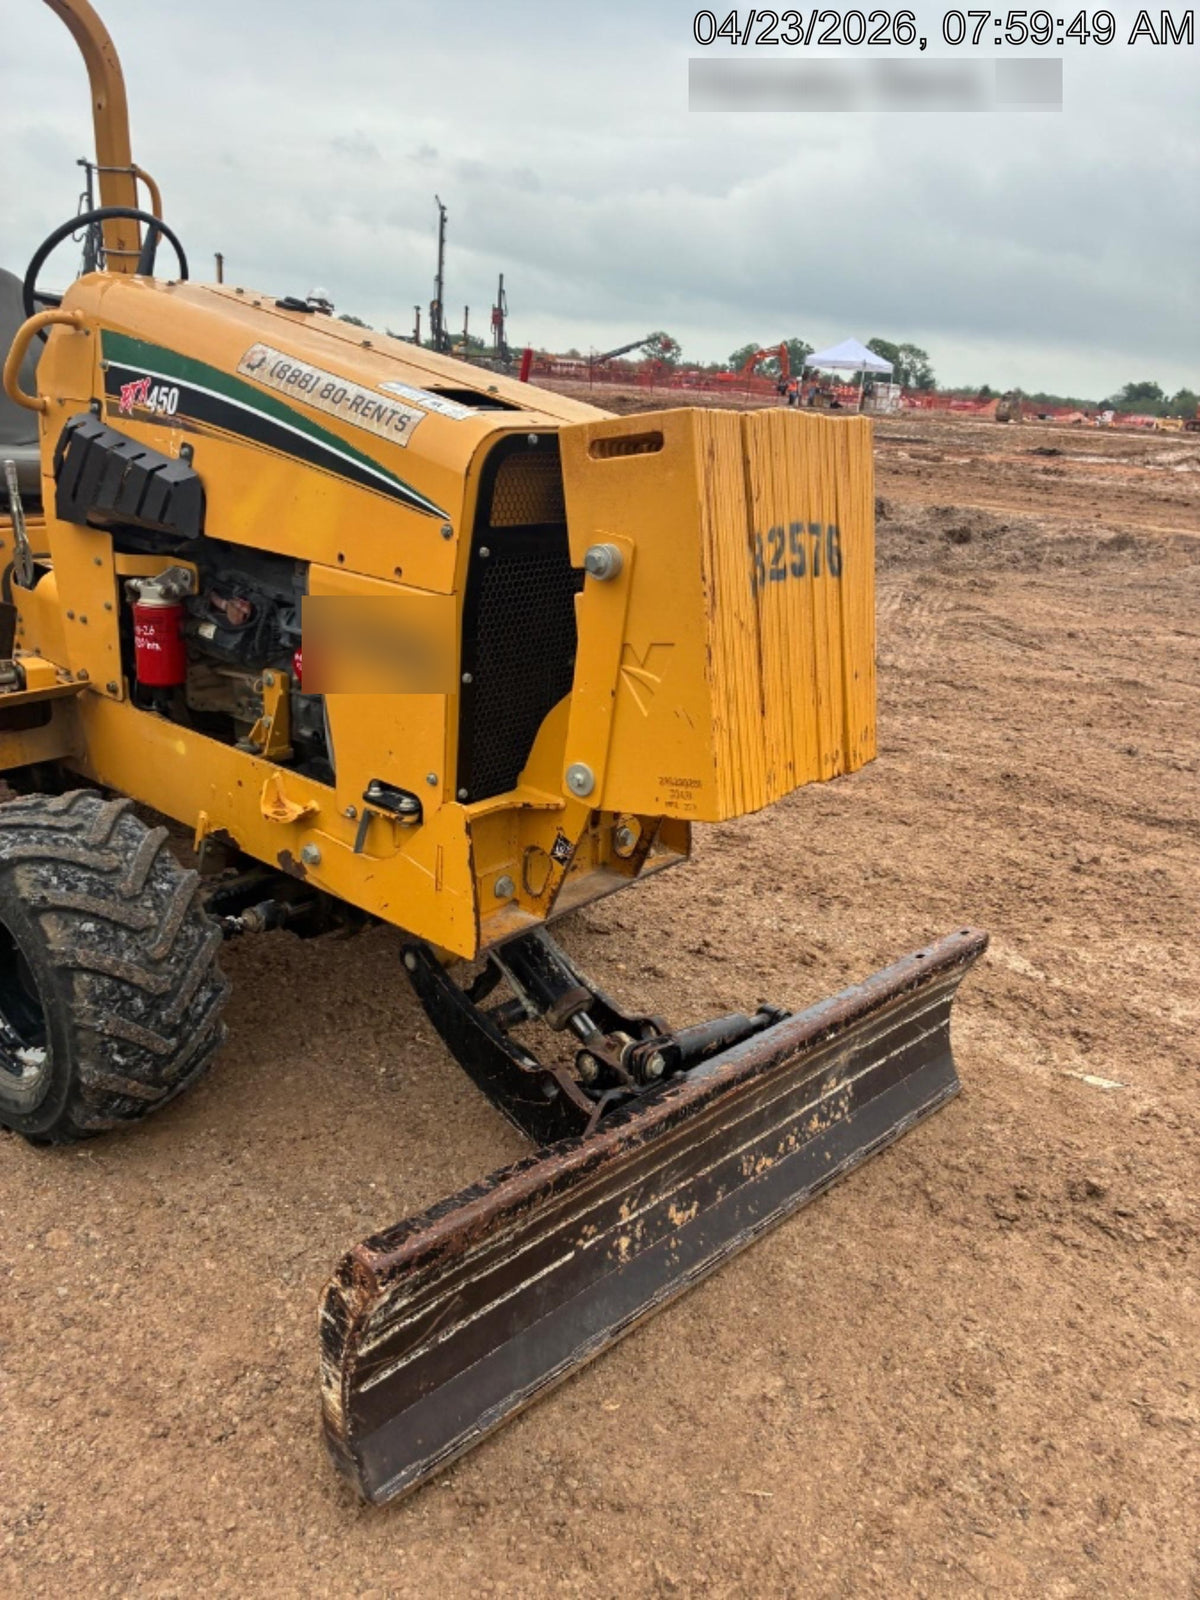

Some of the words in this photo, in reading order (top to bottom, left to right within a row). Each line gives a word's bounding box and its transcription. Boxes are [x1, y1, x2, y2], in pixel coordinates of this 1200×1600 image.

[147, 385, 180, 415] 450
[269, 359, 320, 394] (888)
[319, 382, 411, 433] 80-RENTS
